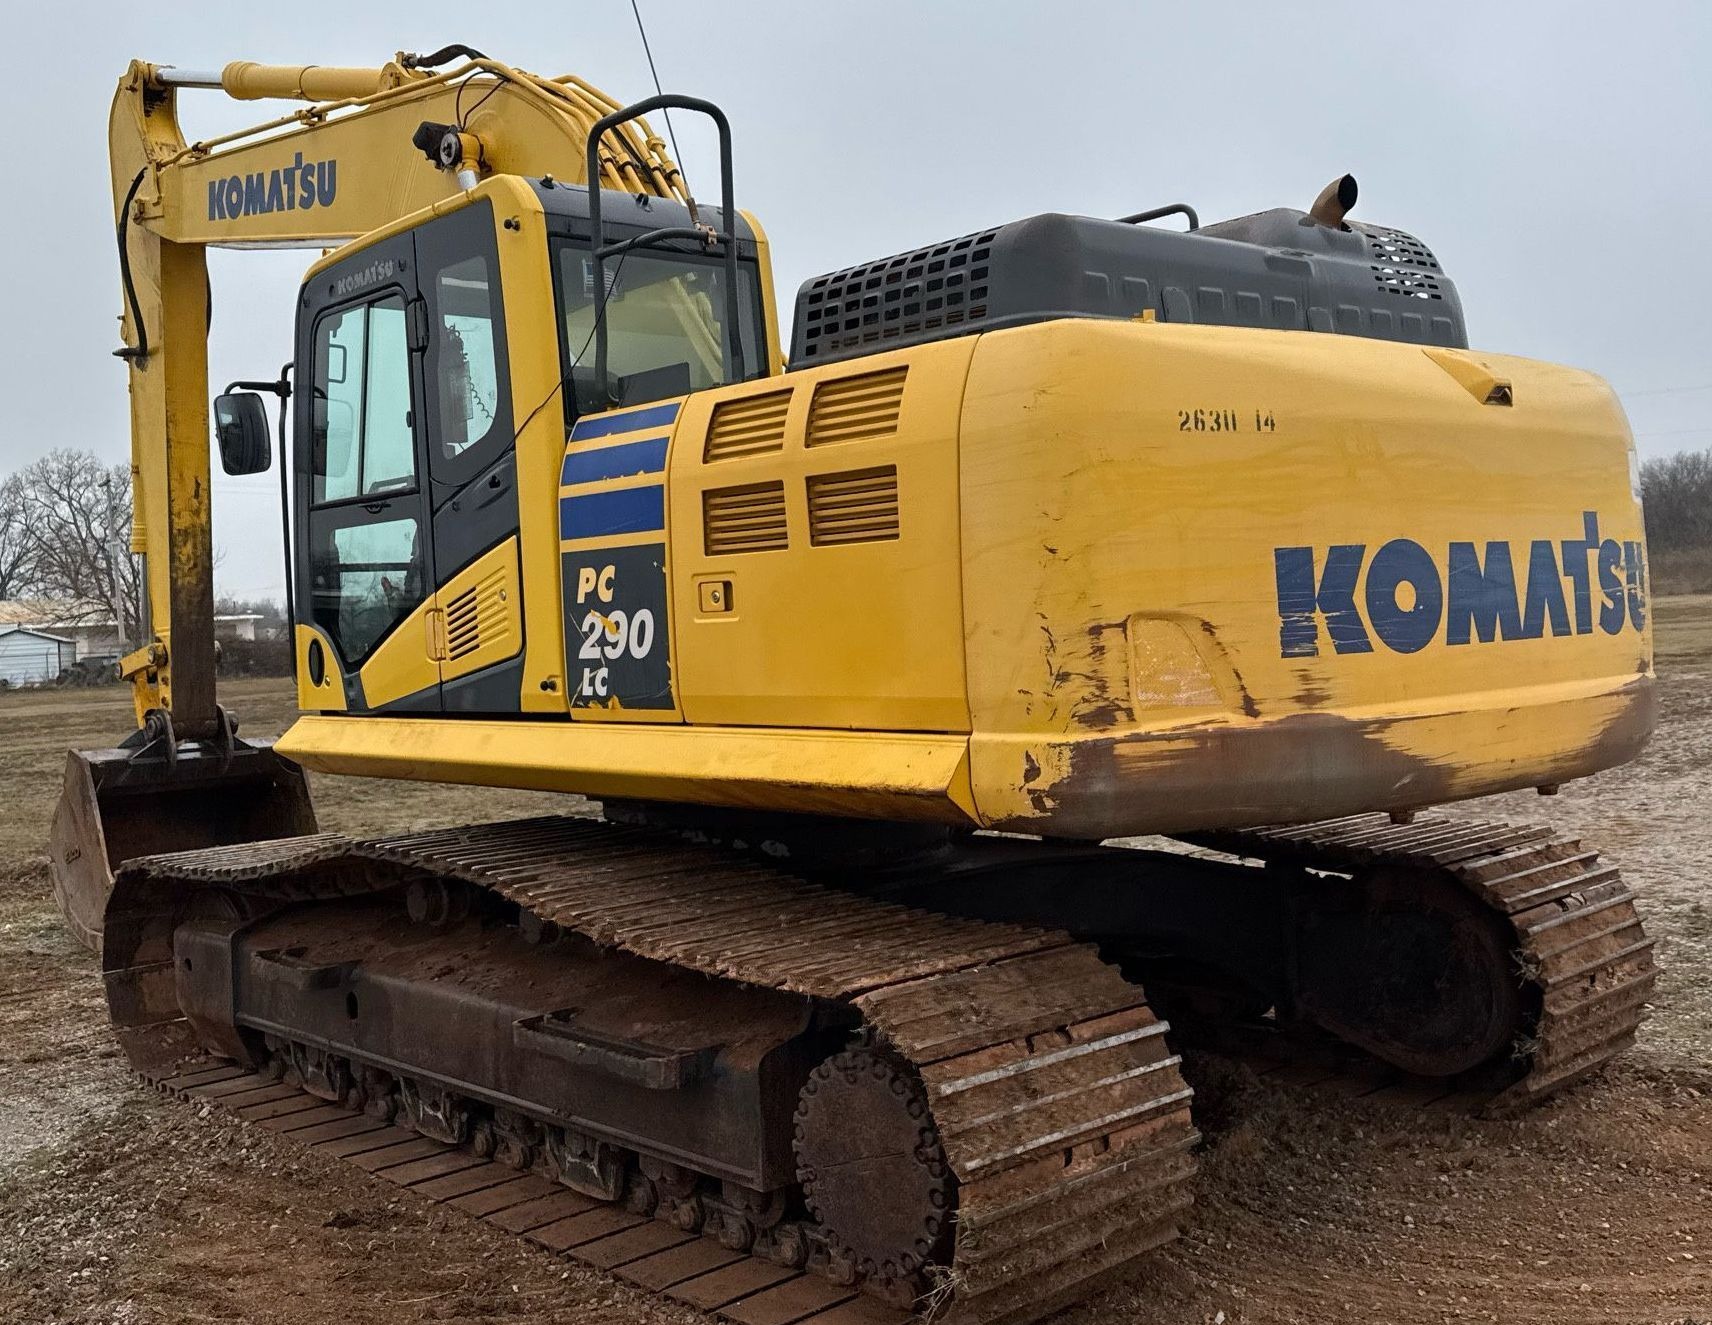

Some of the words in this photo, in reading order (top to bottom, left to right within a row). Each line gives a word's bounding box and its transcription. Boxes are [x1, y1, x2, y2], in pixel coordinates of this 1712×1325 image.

[208, 152, 337, 221] KOMATSU
[338, 260, 393, 295] KOMATSU
[1256, 409, 1275, 432] 14
[576, 564, 616, 604] PC
[1274, 511, 1646, 658] KOMATSU
[578, 608, 654, 660] 290
[582, 667, 609, 697] LC
